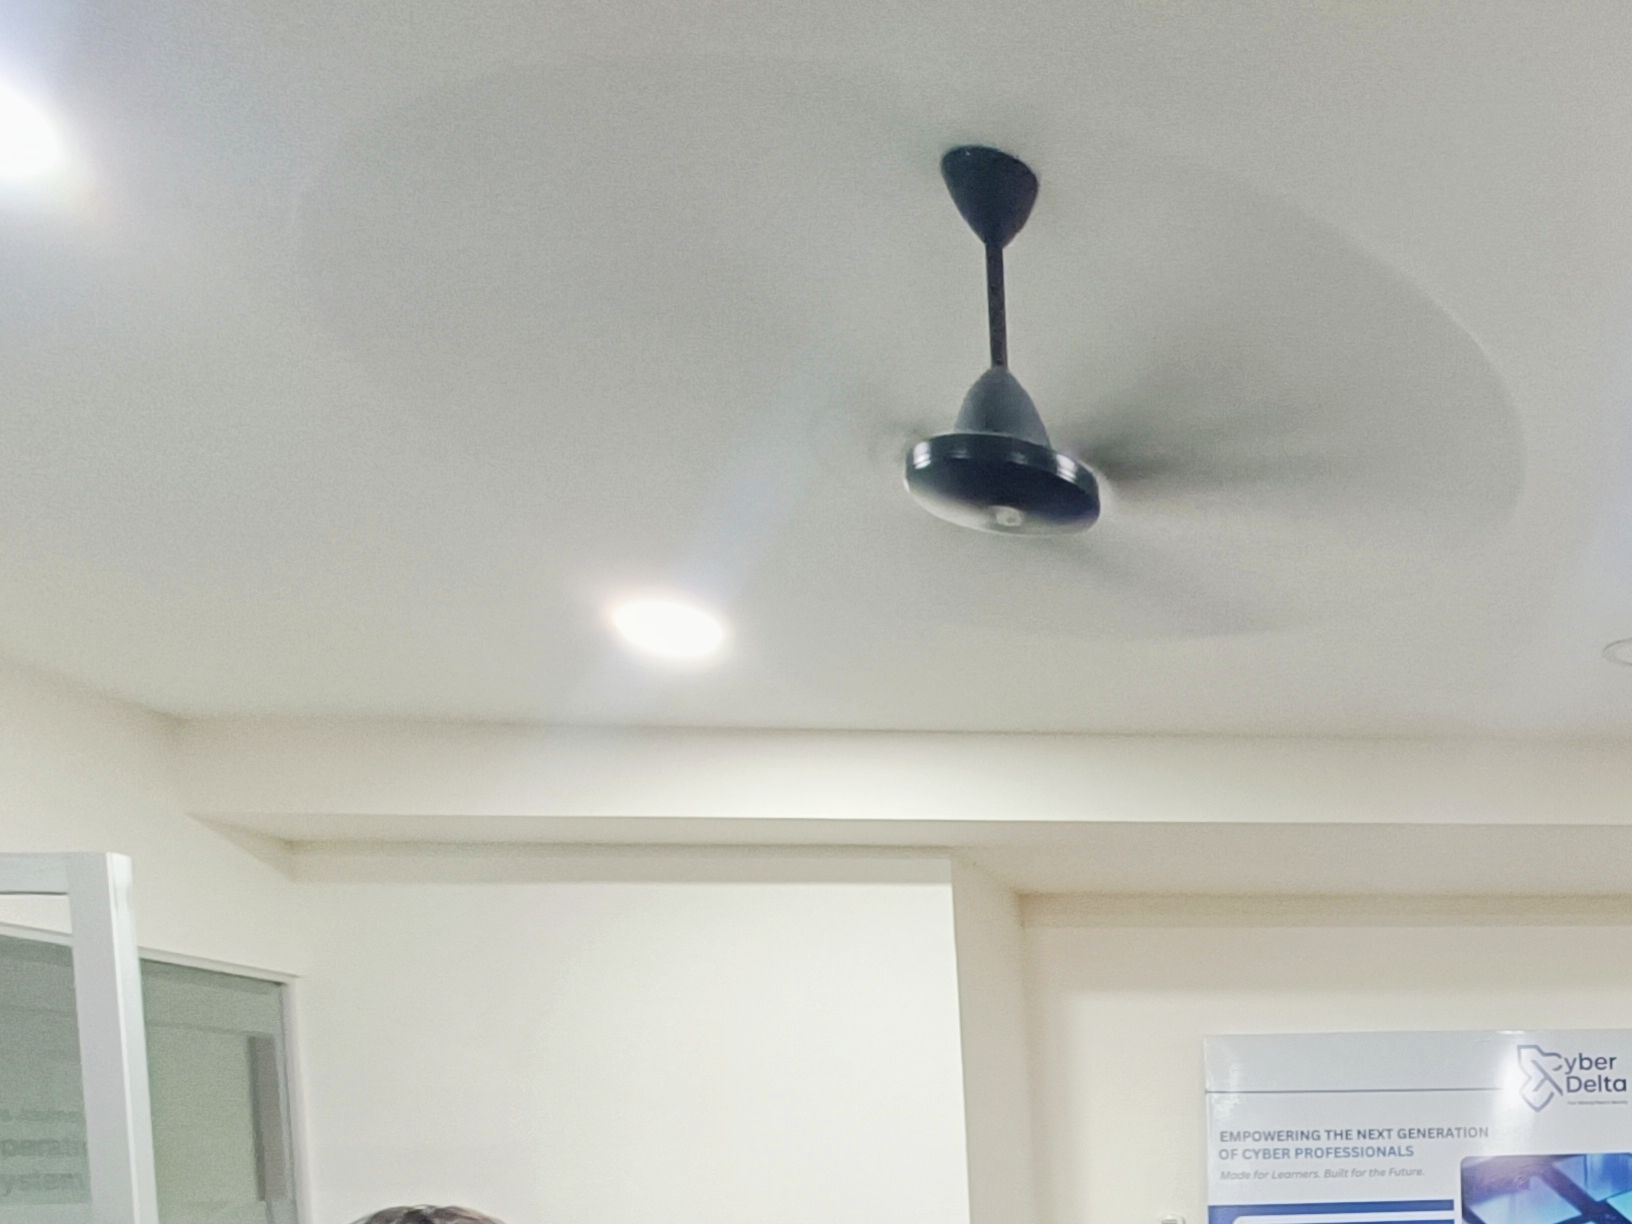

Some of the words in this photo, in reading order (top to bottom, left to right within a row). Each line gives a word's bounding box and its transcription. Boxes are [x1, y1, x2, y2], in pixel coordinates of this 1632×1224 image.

[1566, 1074, 1627, 1093] Delta
[1220, 1130, 1321, 1143] EMPOWERING
[1325, 1129, 1353, 1141] THE
[1357, 1129, 1393, 1141] NEXT
[1397, 1127, 1489, 1140] GENERATION
[1218, 1149, 1239, 1160] OF
[1242, 1147, 1291, 1160] CYBER
[1295, 1145, 1414, 1159] PROFESSIONALS
[1220, 1170, 1251, 1181] Made
[1253, 1169, 1269, 1180] for
[1271, 1169, 1321, 1180] Learners.
[1323, 1168, 1348, 1179] Built
[1350, 1168, 1367, 1178] for
[1368, 1167, 1386, 1178] the
[1388, 1166, 1425, 1177] Future.
